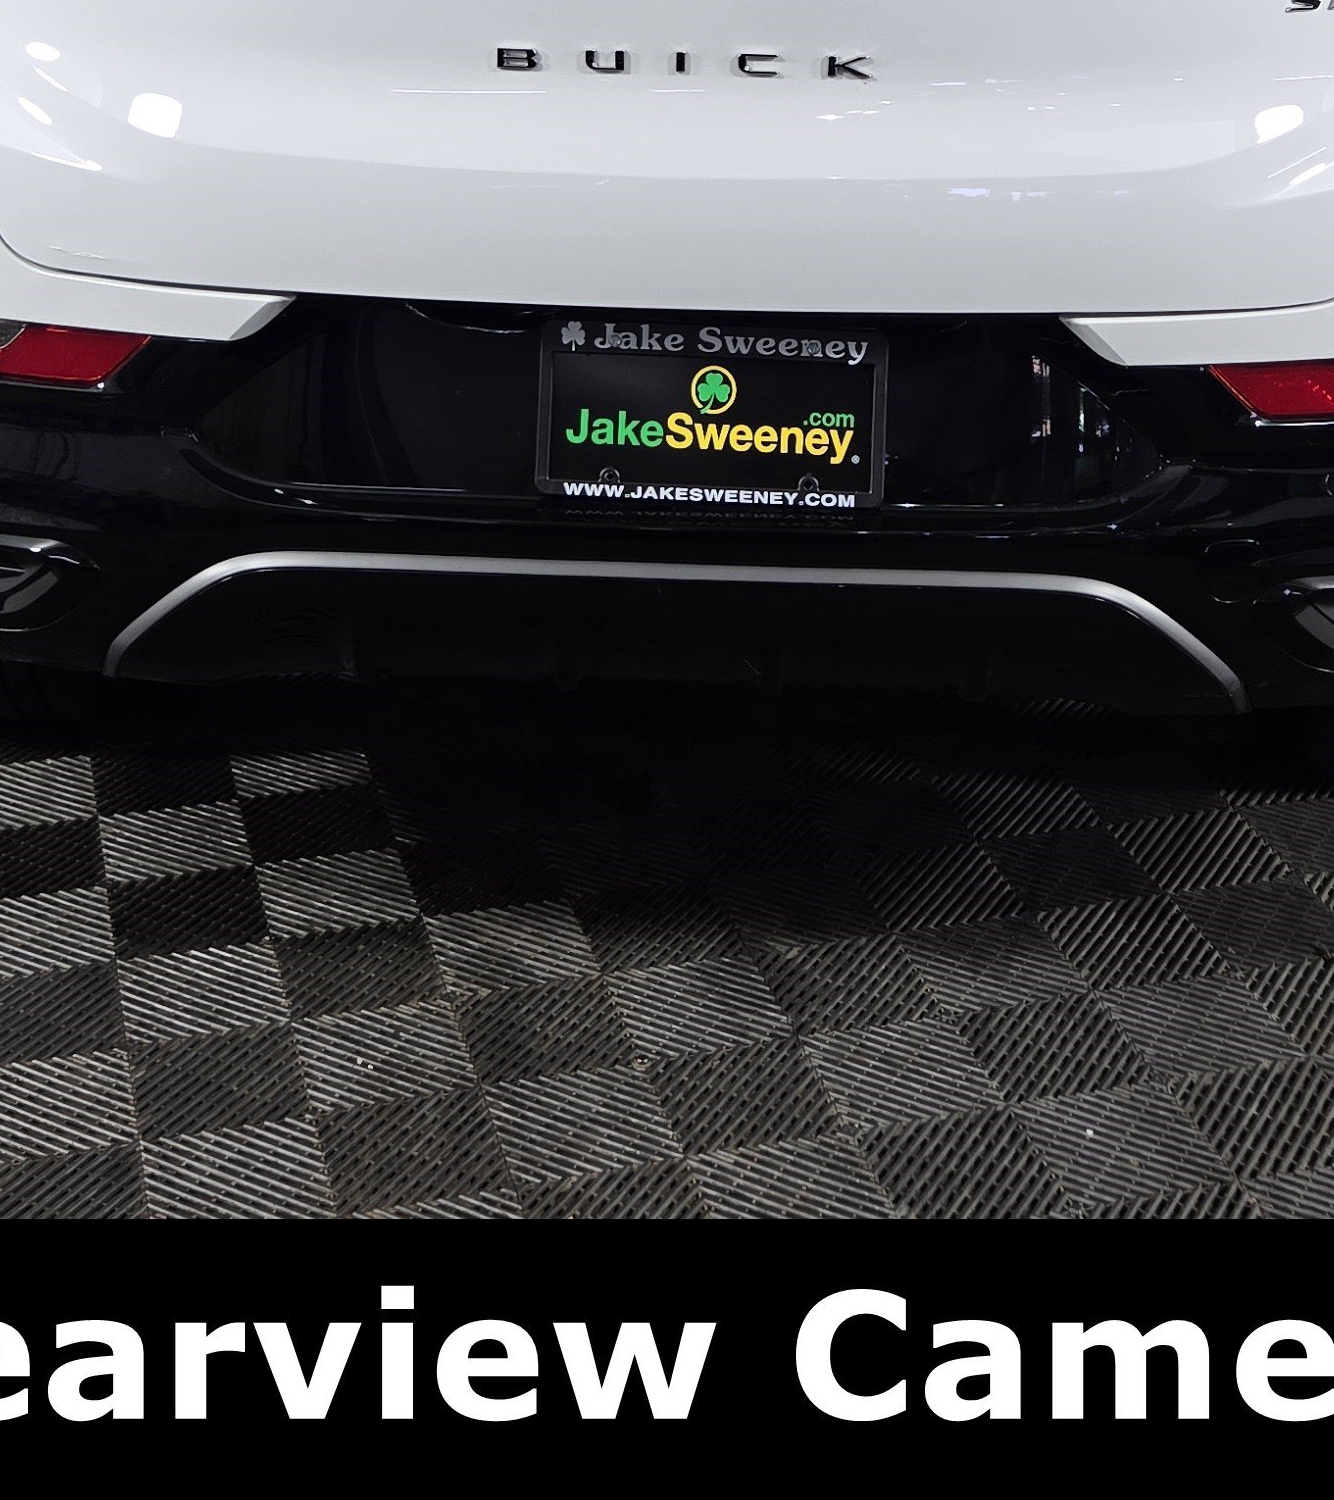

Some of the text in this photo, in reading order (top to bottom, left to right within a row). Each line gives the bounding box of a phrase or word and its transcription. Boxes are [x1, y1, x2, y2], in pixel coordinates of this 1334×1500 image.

[496, 46, 874, 79] BUICK
[594, 323, 869, 365] Jake Sweeney
[563, 481, 856, 508] WWW.JAKESWEENEY.COM
